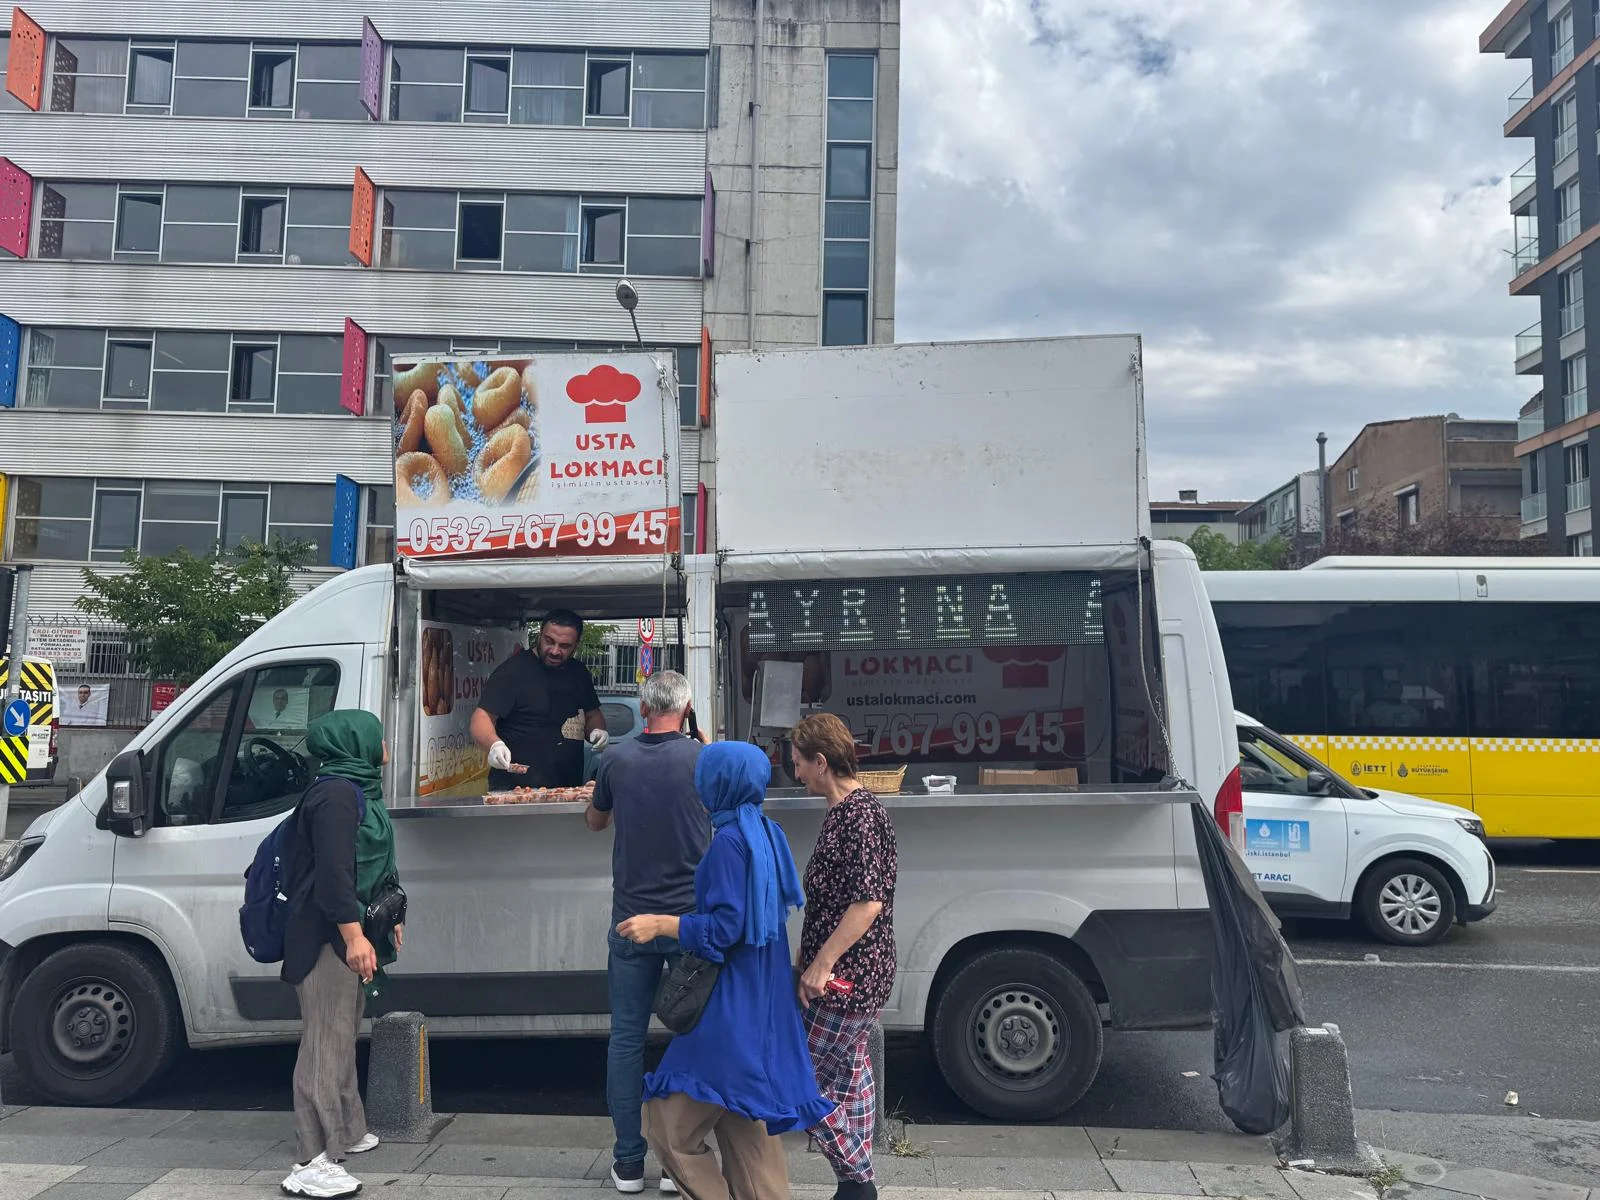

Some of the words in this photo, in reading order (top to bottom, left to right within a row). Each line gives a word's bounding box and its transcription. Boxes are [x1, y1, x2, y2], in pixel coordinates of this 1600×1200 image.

[575, 432, 636, 451] USTA
[550, 459, 663, 479] LOKMACI
[408, 515, 492, 552] 0532
[501, 514, 565, 550] 767
[575, 512, 617, 548] 99
[627, 511, 668, 546] 45
[641, 617, 652, 633] 30
[467, 639, 496, 664] USTA
[843, 653, 973, 676] LOKMACI
[19, 689, 52, 704] TAŞITI
[847, 691, 977, 706] ustalokmaci.com
[863, 713, 939, 757] 767
[952, 711, 1001, 755] 99
[1015, 710, 1066, 753] 45
[1245, 849, 1292, 858] .iski.istanbul
[1263, 872, 1292, 882] ARACI
